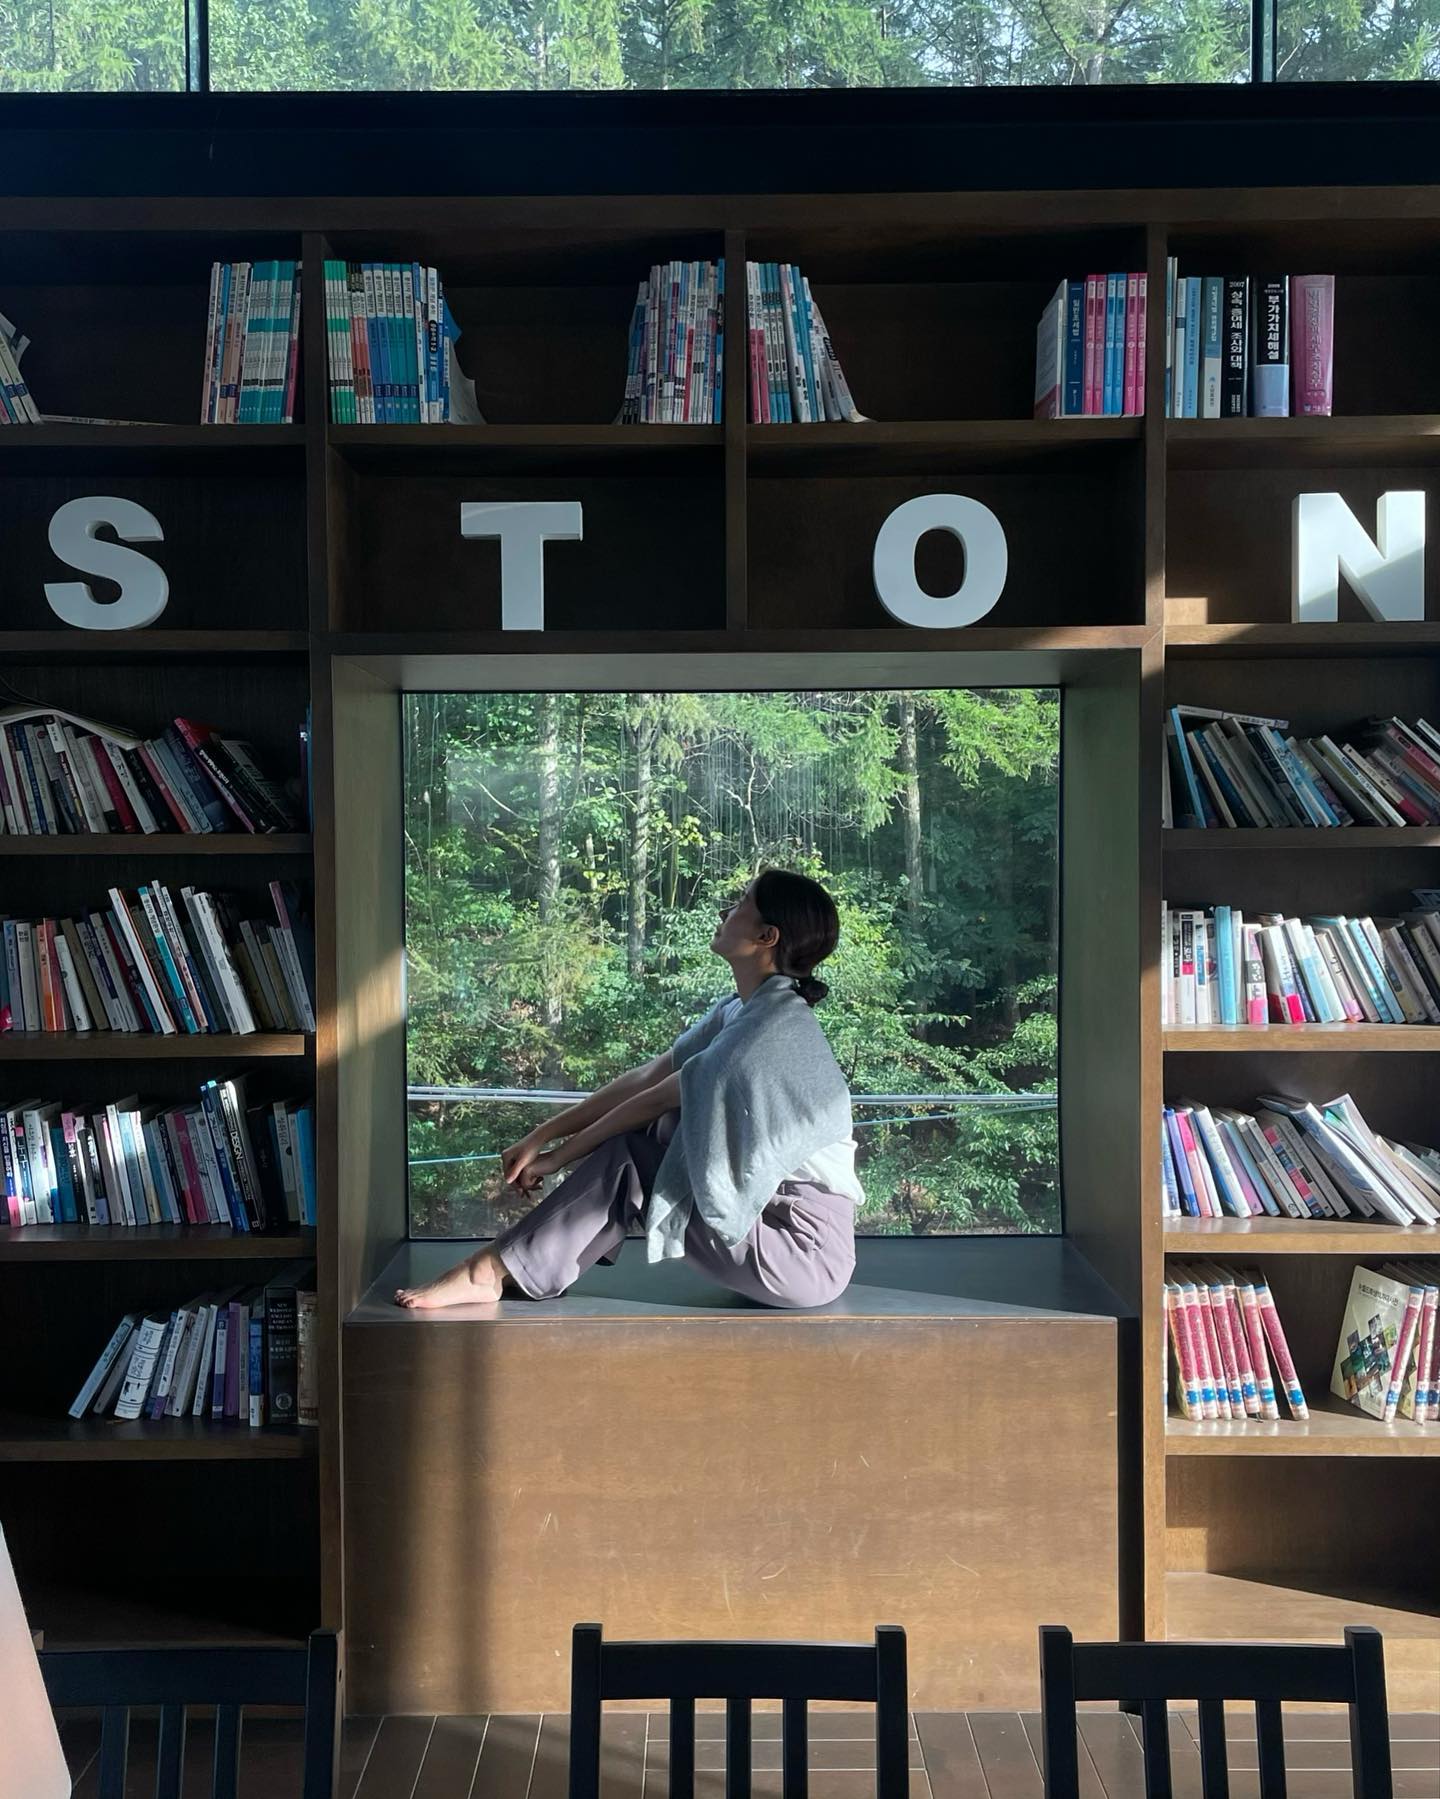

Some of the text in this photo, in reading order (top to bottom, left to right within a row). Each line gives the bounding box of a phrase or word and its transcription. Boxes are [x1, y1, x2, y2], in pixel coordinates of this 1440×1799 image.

[1230, 355, 1243, 369] 대책
[44, 489, 1426, 632] S T O N
[230, 1131, 243, 1160] DESIGN
